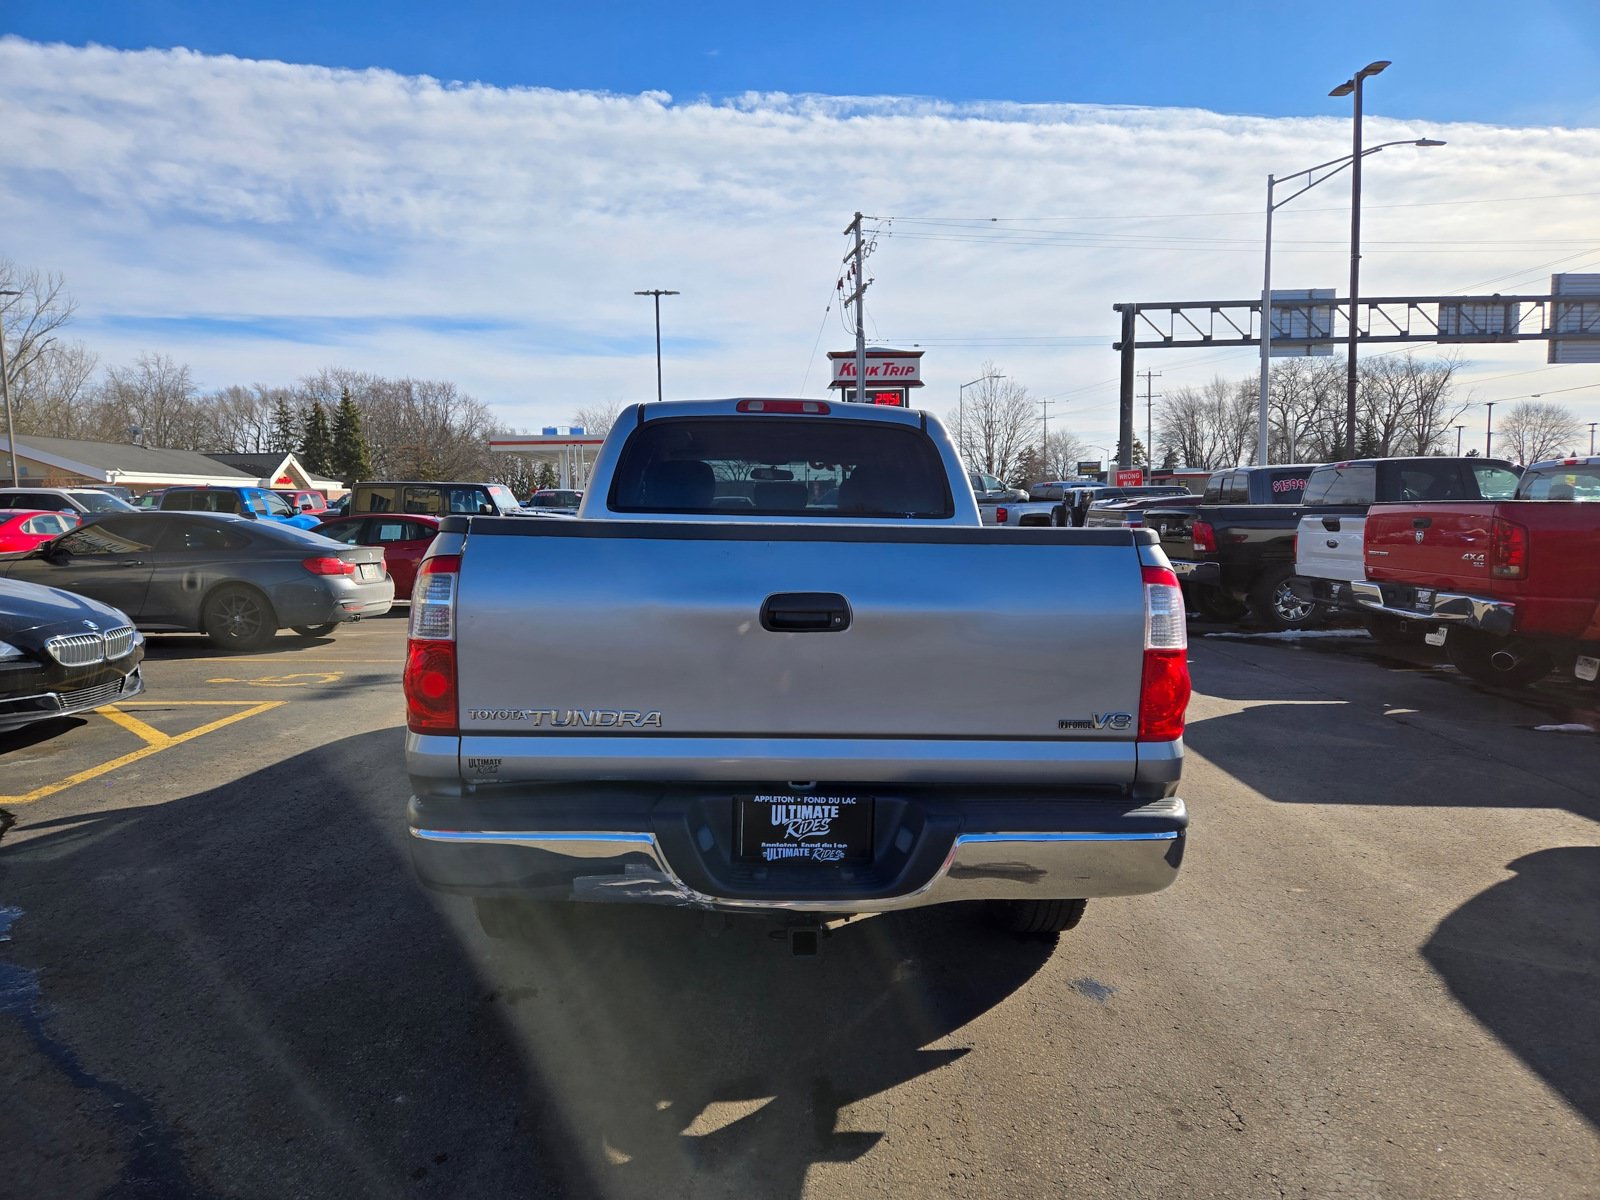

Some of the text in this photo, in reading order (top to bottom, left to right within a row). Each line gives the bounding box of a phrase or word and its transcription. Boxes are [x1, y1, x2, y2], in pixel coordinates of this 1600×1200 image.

[883, 362, 915, 377] TRIP
[1119, 472, 1140, 480] WRONG
[1272, 478, 1307, 493] $1599
[468, 709, 662, 727] TOYOTA TUNDRA
[1092, 712, 1132, 730] V8
[468, 758, 502, 768] ULTIMATE
[754, 795, 794, 803] APPLETON
[803, 796, 826, 804] FOND
[771, 804, 839, 826] ULTIMATE
[766, 848, 843, 861] ULTIMATE RIDES
